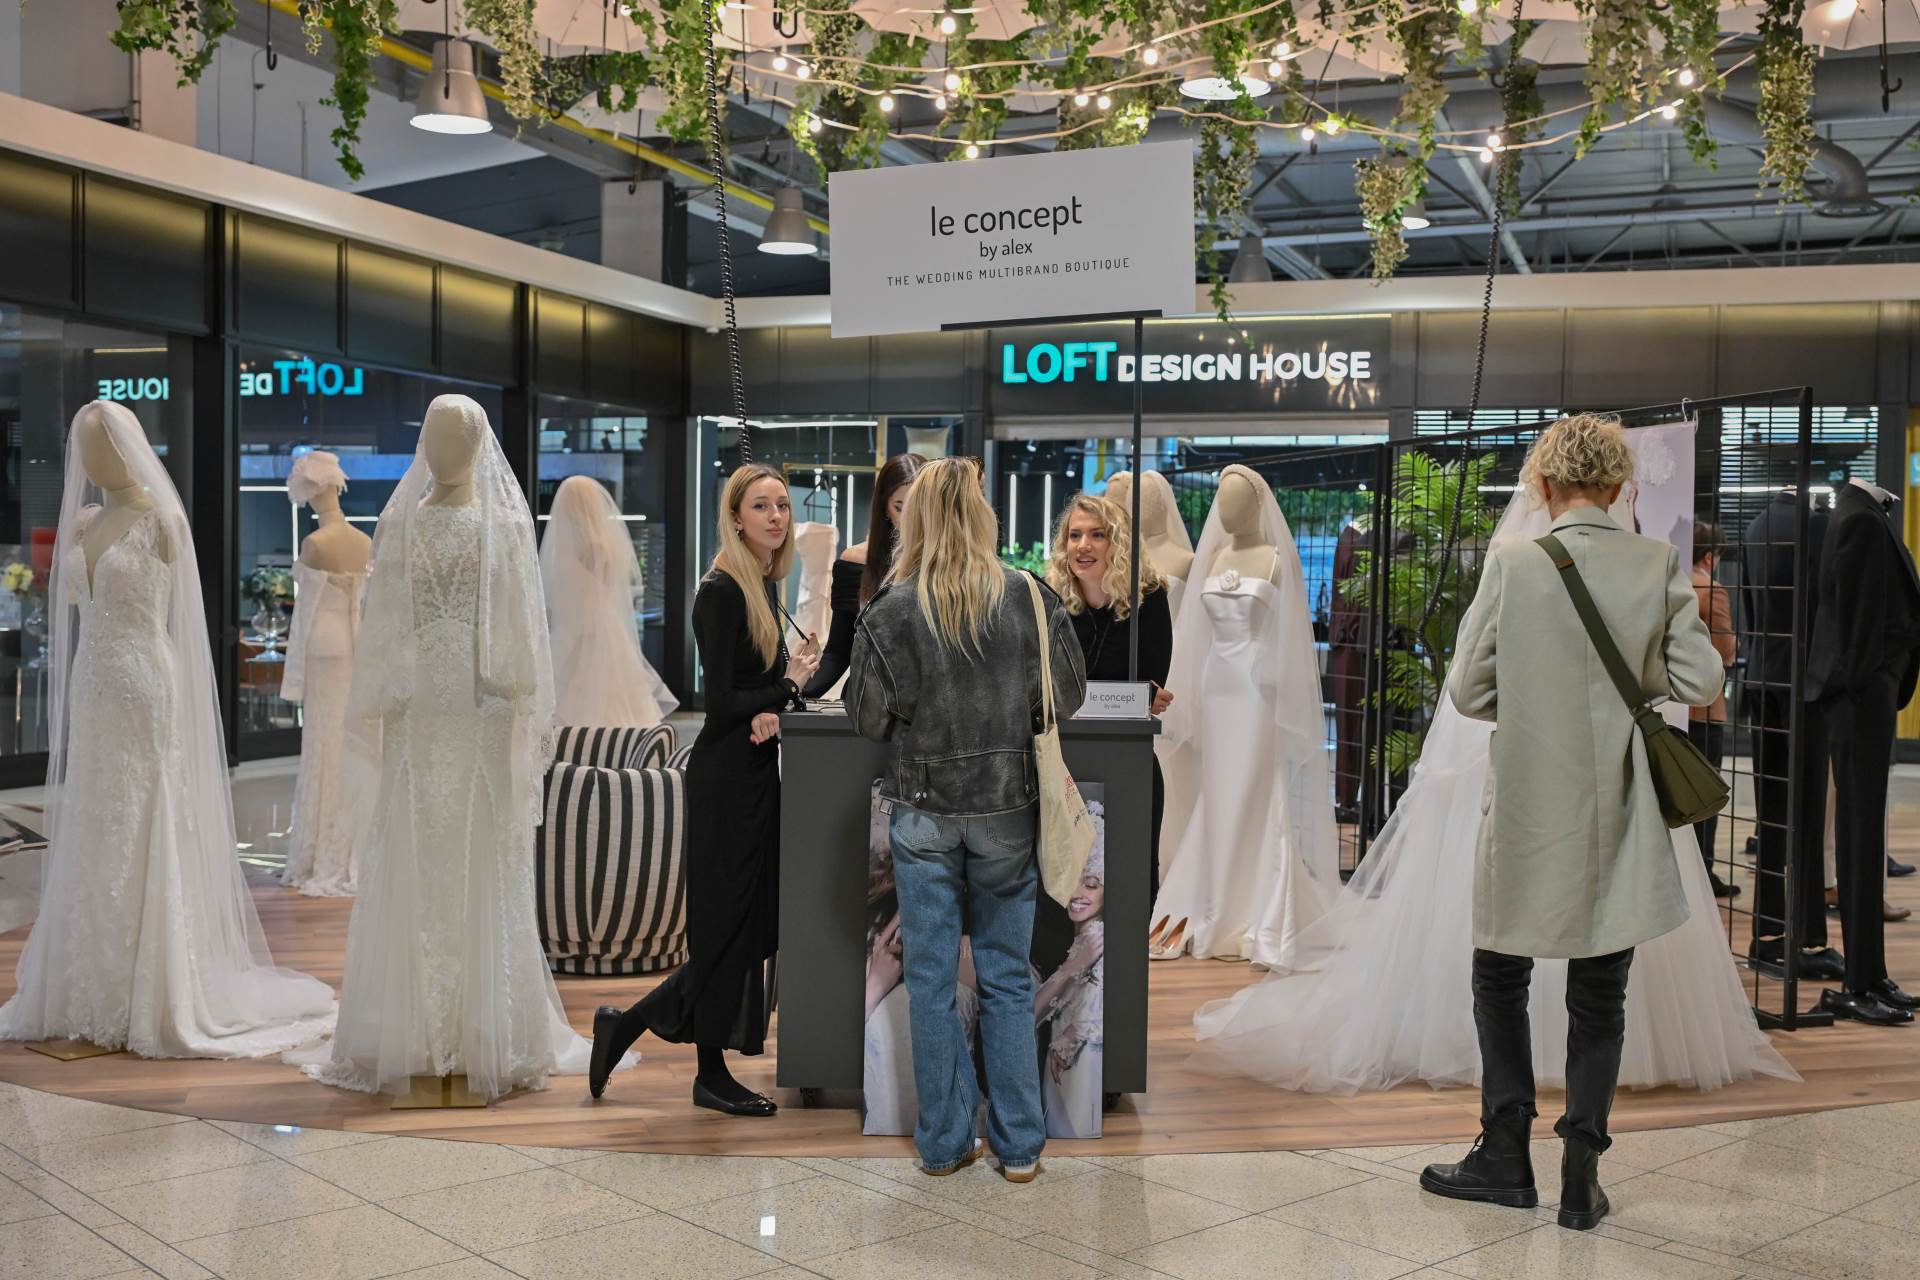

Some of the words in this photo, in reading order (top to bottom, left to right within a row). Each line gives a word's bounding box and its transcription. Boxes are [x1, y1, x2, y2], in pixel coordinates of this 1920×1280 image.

[931, 205, 955, 237] le
[964, 195, 1083, 236] concept
[979, 240, 998, 262] by
[1001, 238, 1033, 256] alex
[887, 275, 910, 287] THE
[916, 270, 973, 285] WEDDING
[979, 263, 1059, 280] MULTIBRAND
[1065, 257, 1130, 273] BOUTIQUE
[1003, 341, 1117, 383] LOFT
[1117, 353, 1242, 382] DESIGN
[1249, 351, 1372, 380] HOUSE
[1089, 691, 1098, 702] le
[1100, 692, 1136, 704] concept
